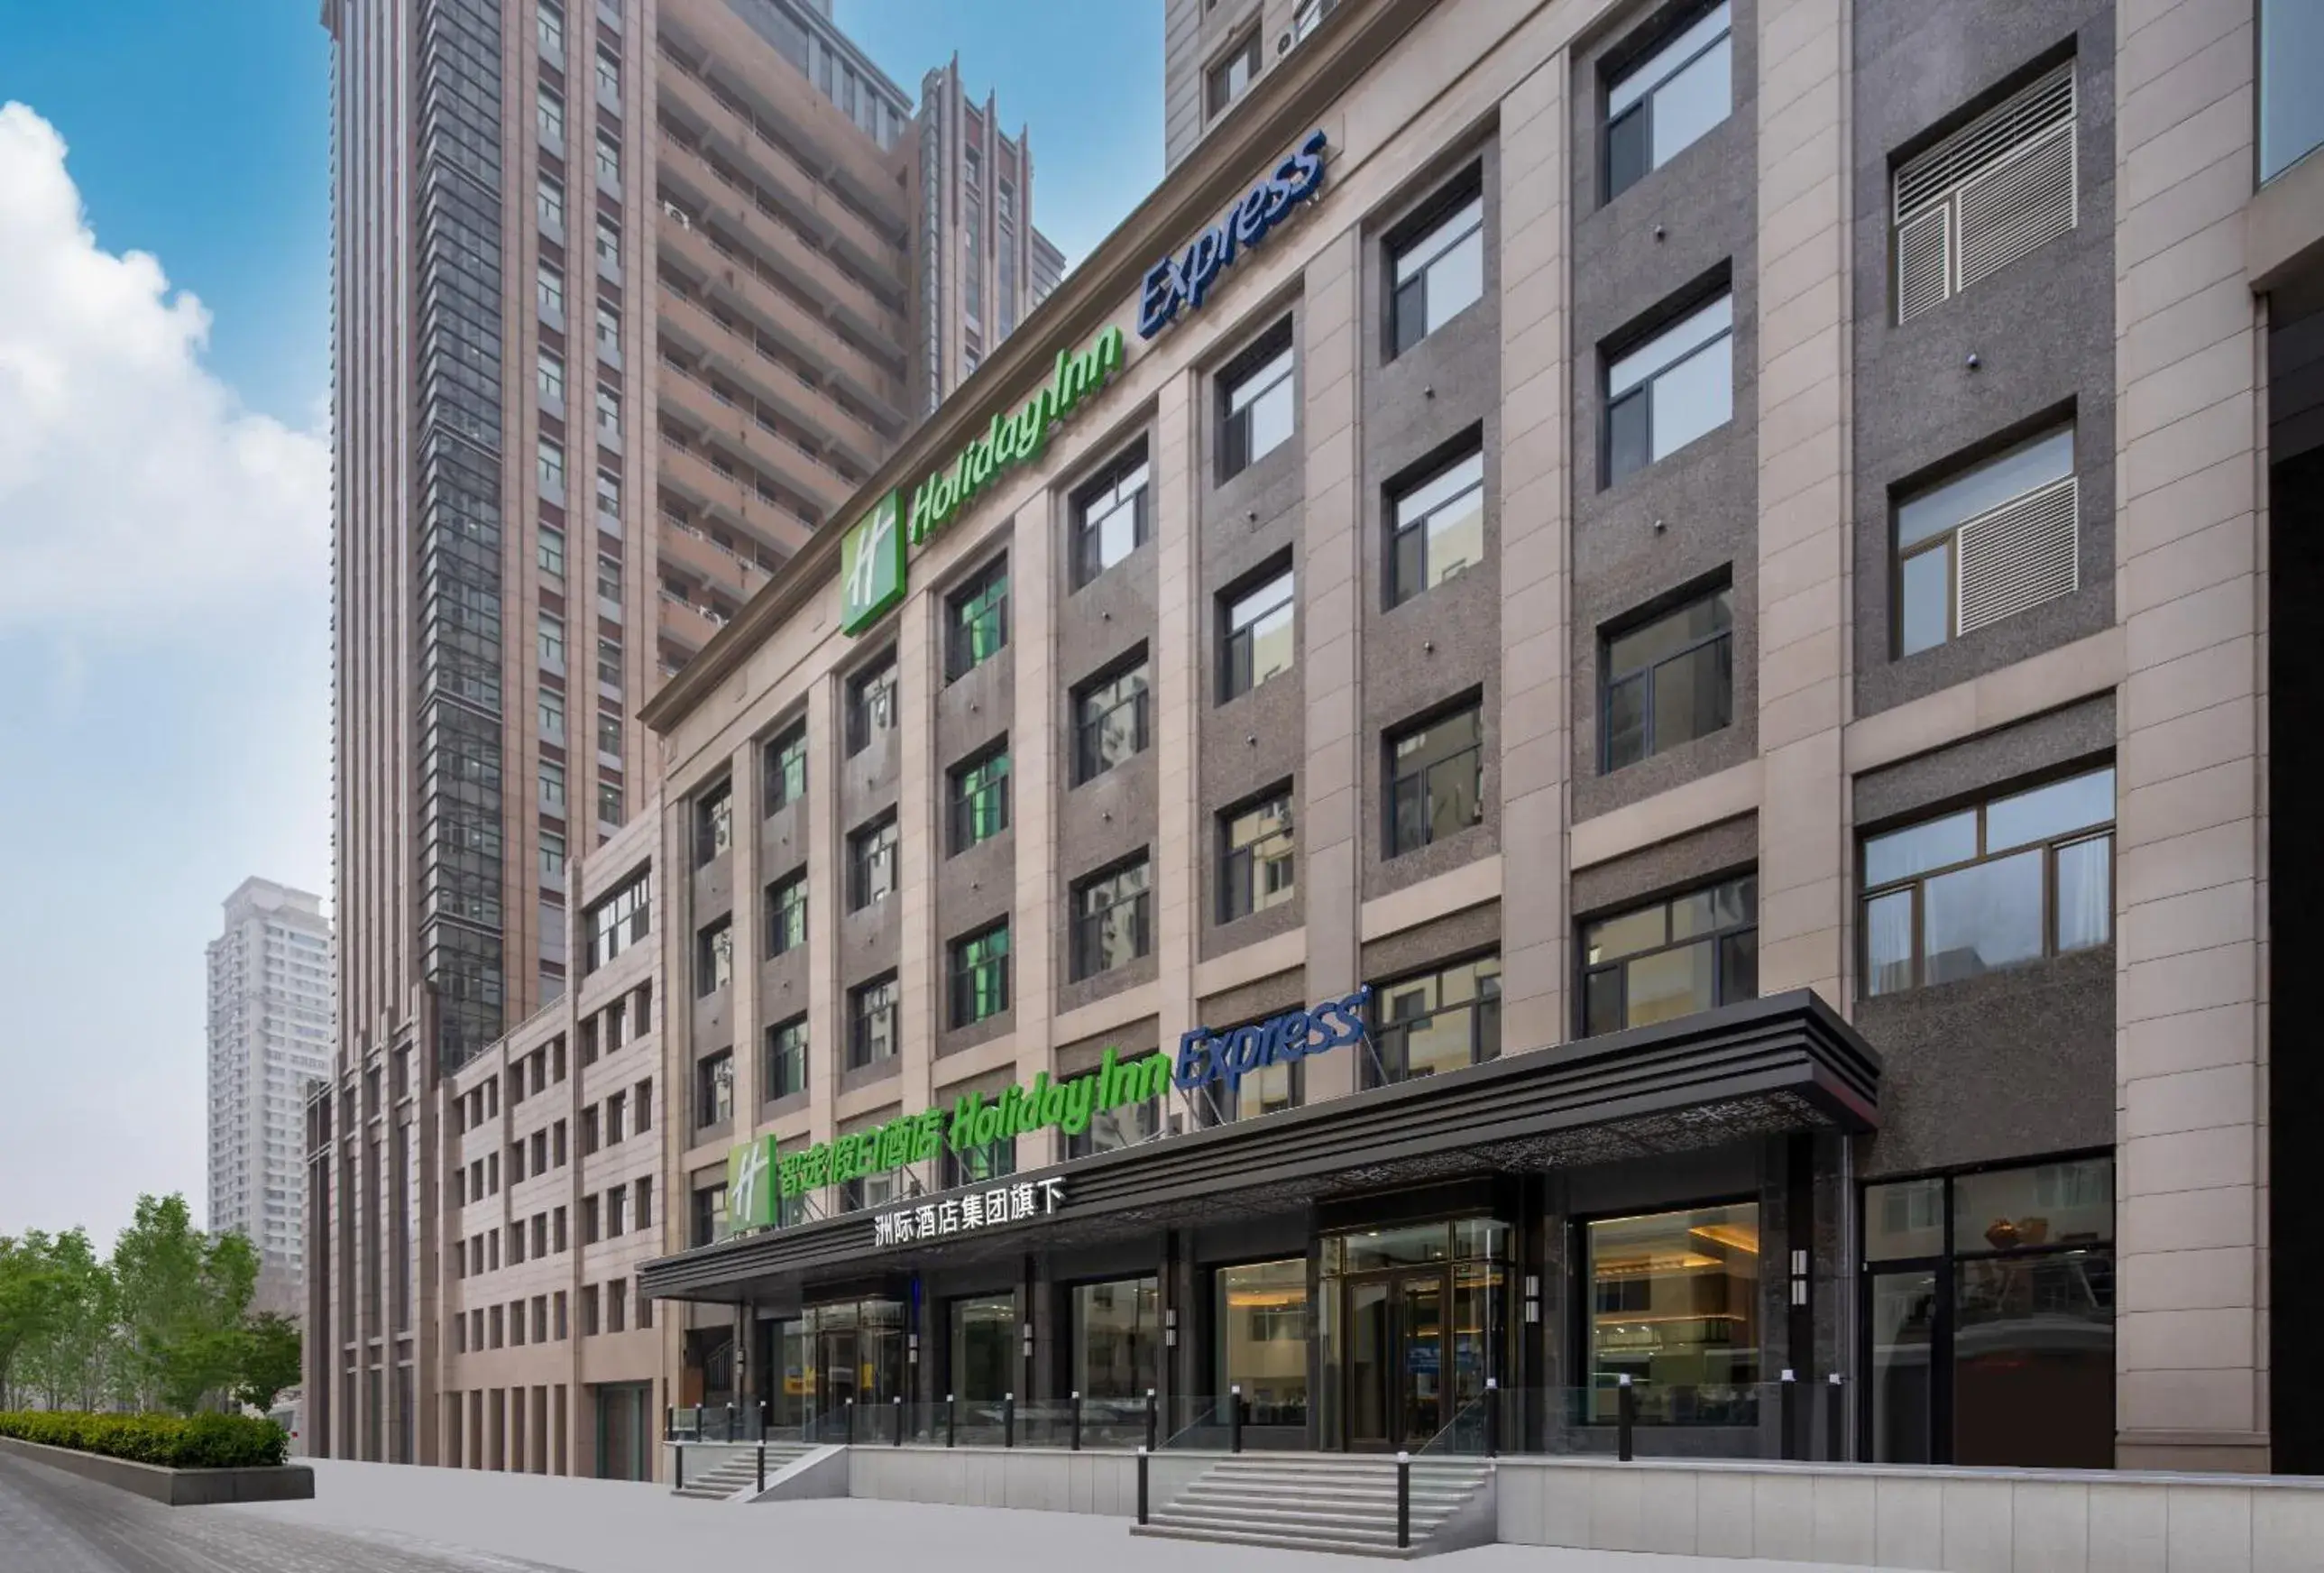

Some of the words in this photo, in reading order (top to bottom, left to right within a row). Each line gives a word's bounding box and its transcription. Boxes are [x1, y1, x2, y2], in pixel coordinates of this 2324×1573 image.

[910, 390, 1052, 546] Holiday
[1050, 324, 1124, 420] Inn
[1138, 129, 1327, 340] Express
[949, 1071, 1096, 1153] Holiday
[1098, 1046, 1172, 1115] Inn
[1175, 992, 1368, 1092] Express
[779, 1106, 945, 1198] 智选假日酒店
[874, 1175, 1067, 1247] 洲际酒店集团旗下
